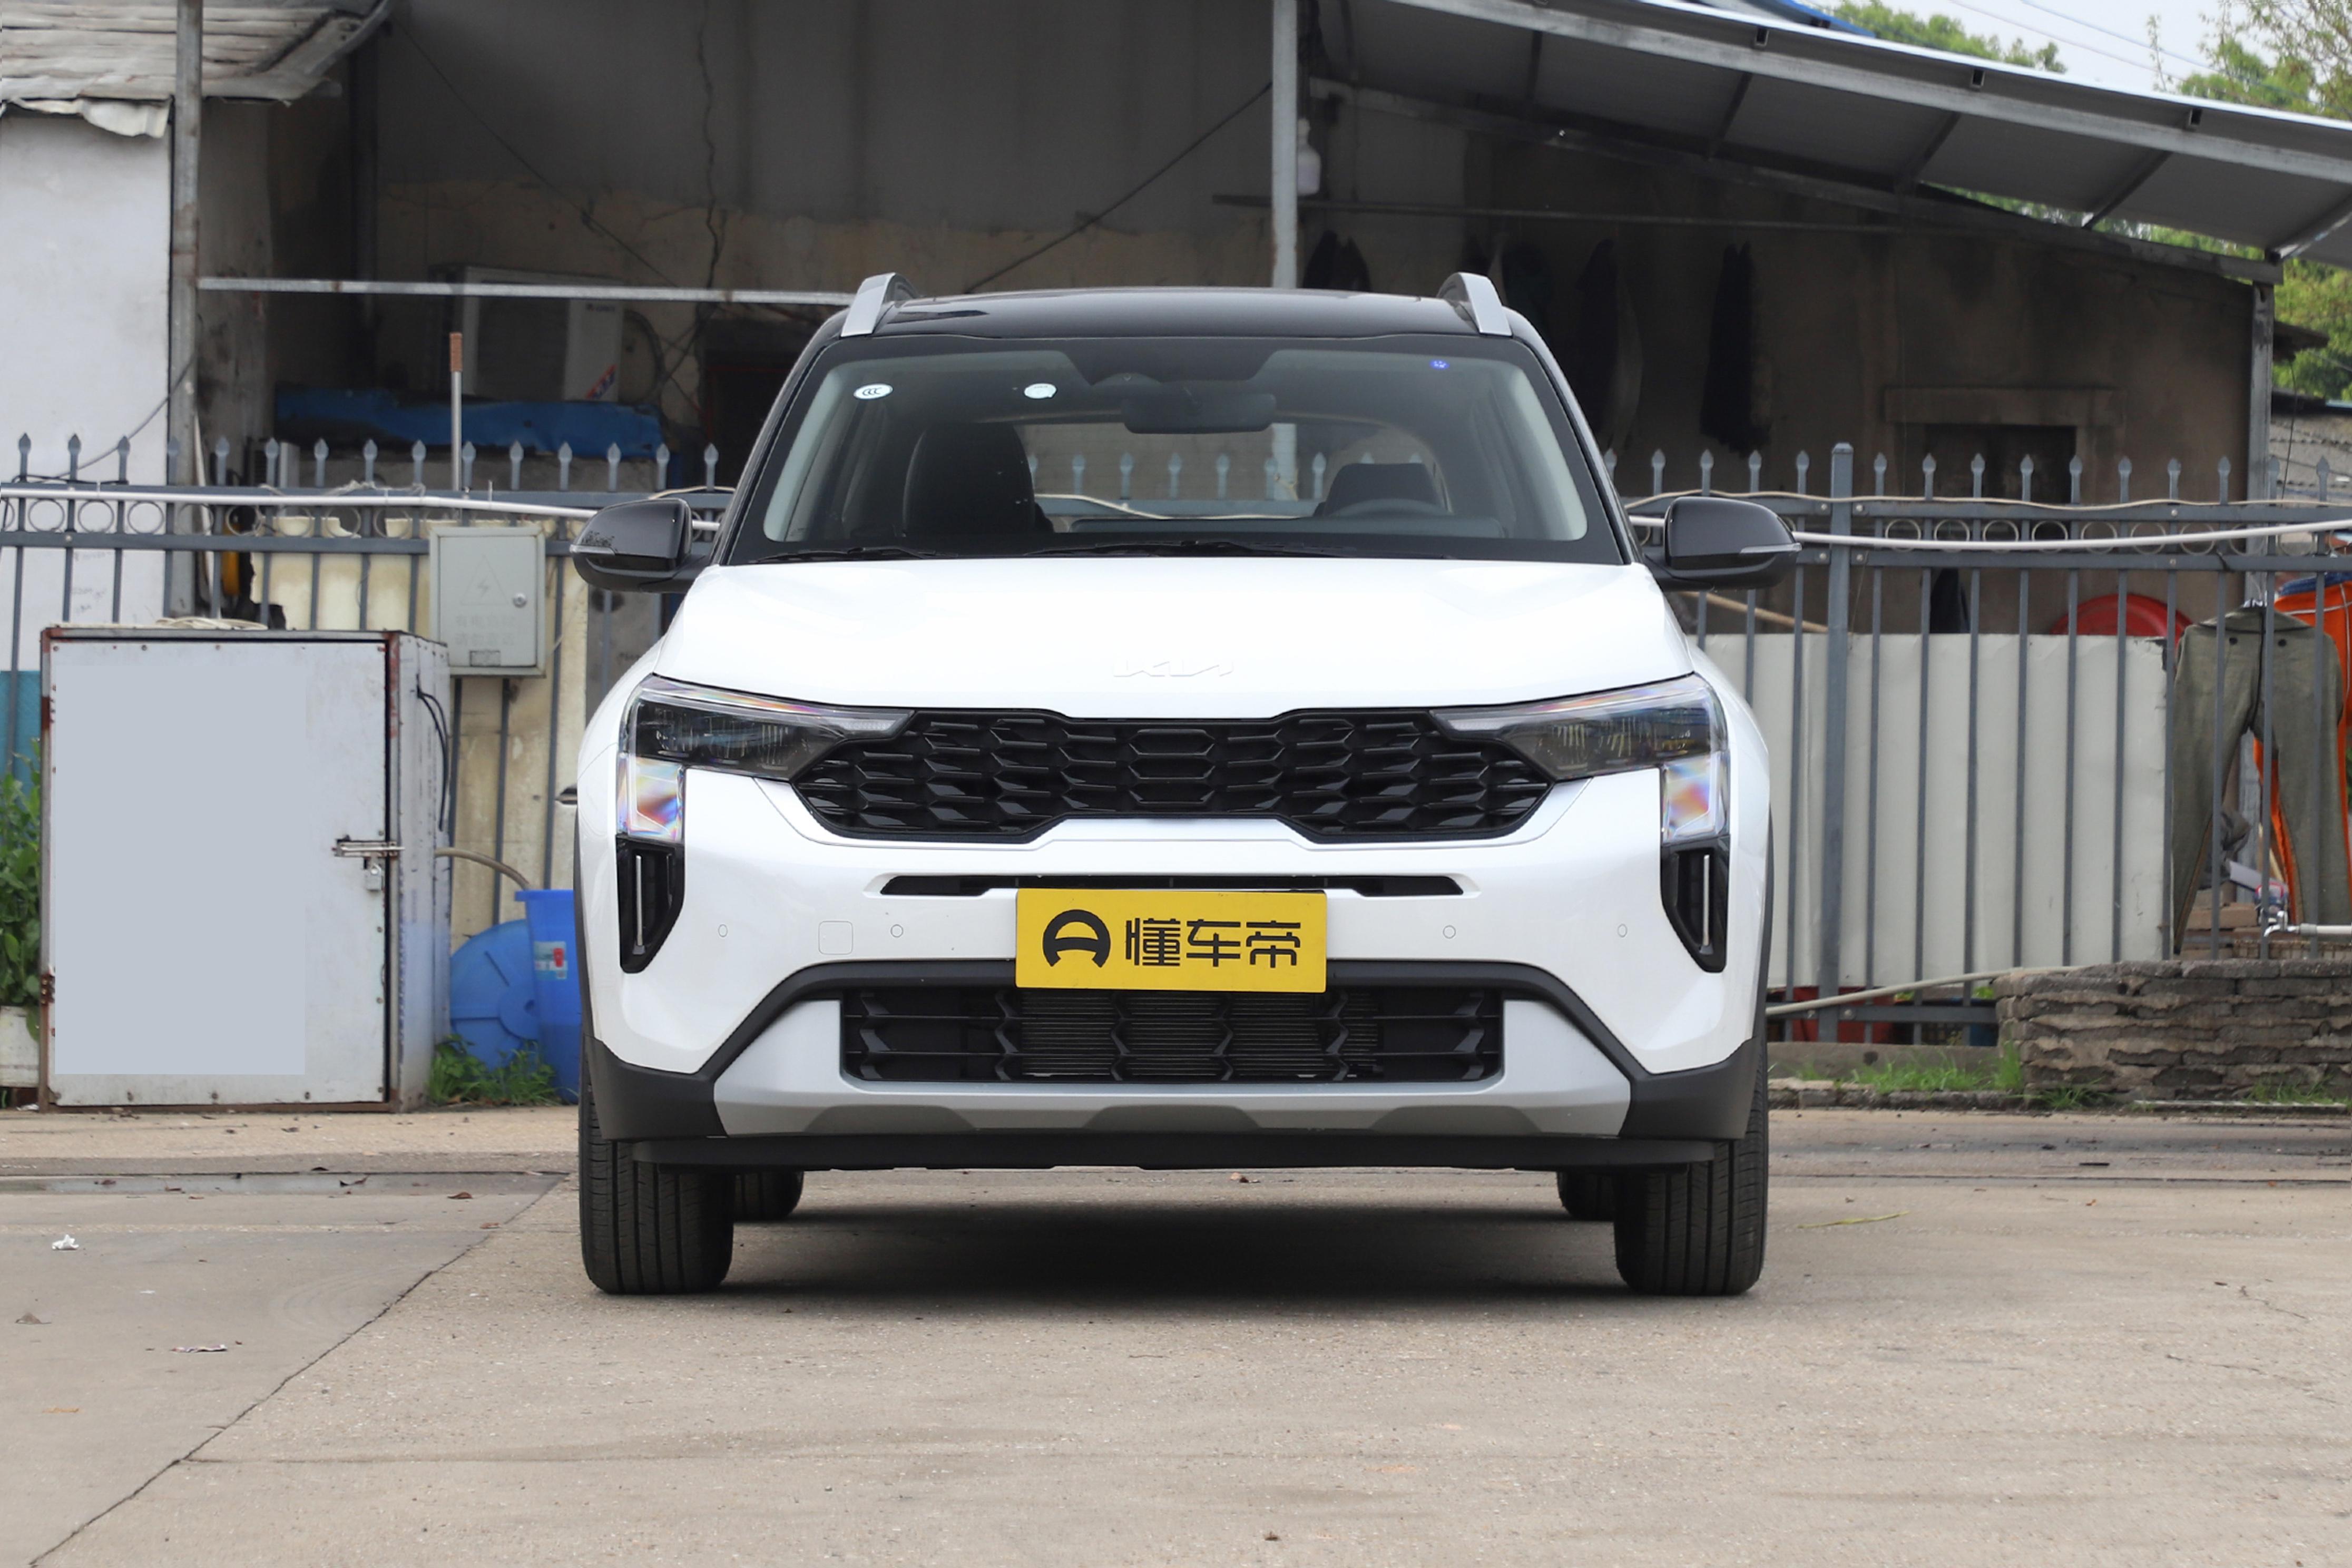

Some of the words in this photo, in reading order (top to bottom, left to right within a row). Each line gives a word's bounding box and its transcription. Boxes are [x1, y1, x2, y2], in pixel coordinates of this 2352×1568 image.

[862, 387, 883, 396] CCC
[1125, 917, 1301, 968] 懂车帝
